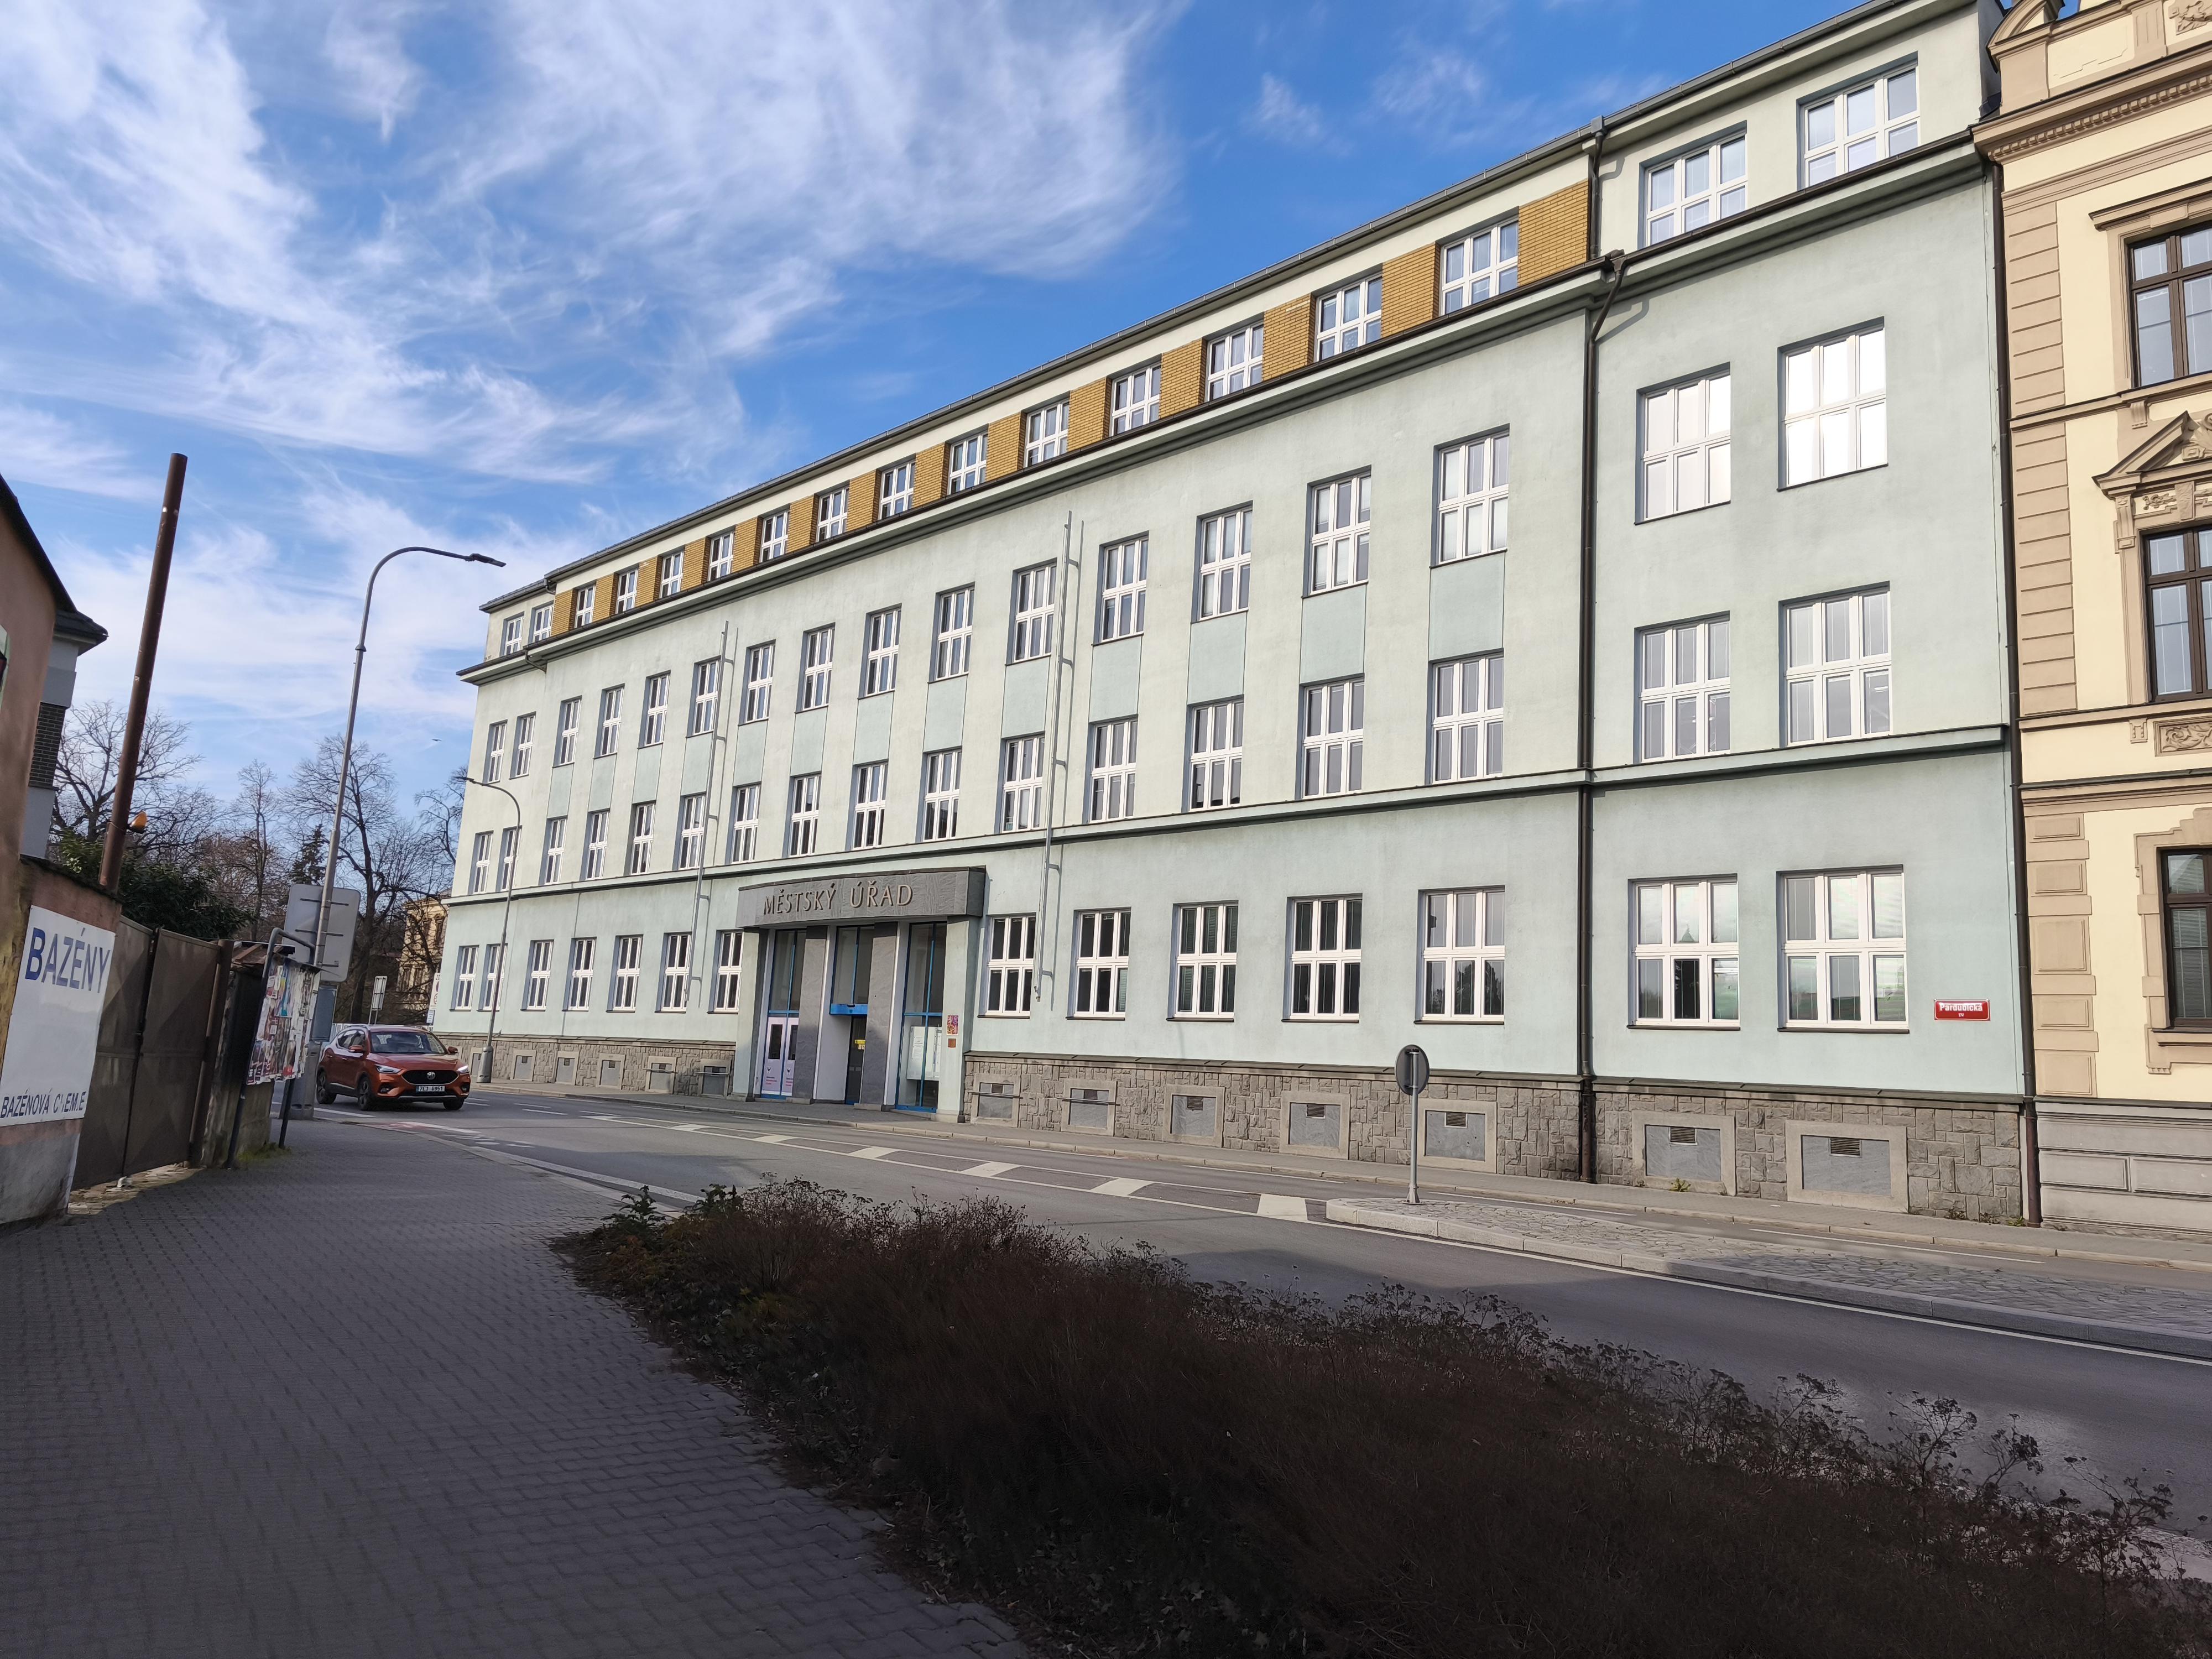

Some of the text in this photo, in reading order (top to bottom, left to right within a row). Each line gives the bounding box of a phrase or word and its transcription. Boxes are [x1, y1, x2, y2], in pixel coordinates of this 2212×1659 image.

[764, 880, 914, 915] MĚSTSKÝ ÚŘAD
[25, 927, 111, 994] BAZÉNY
[0, 1088, 53, 1118] BAZÉNOVÁ
